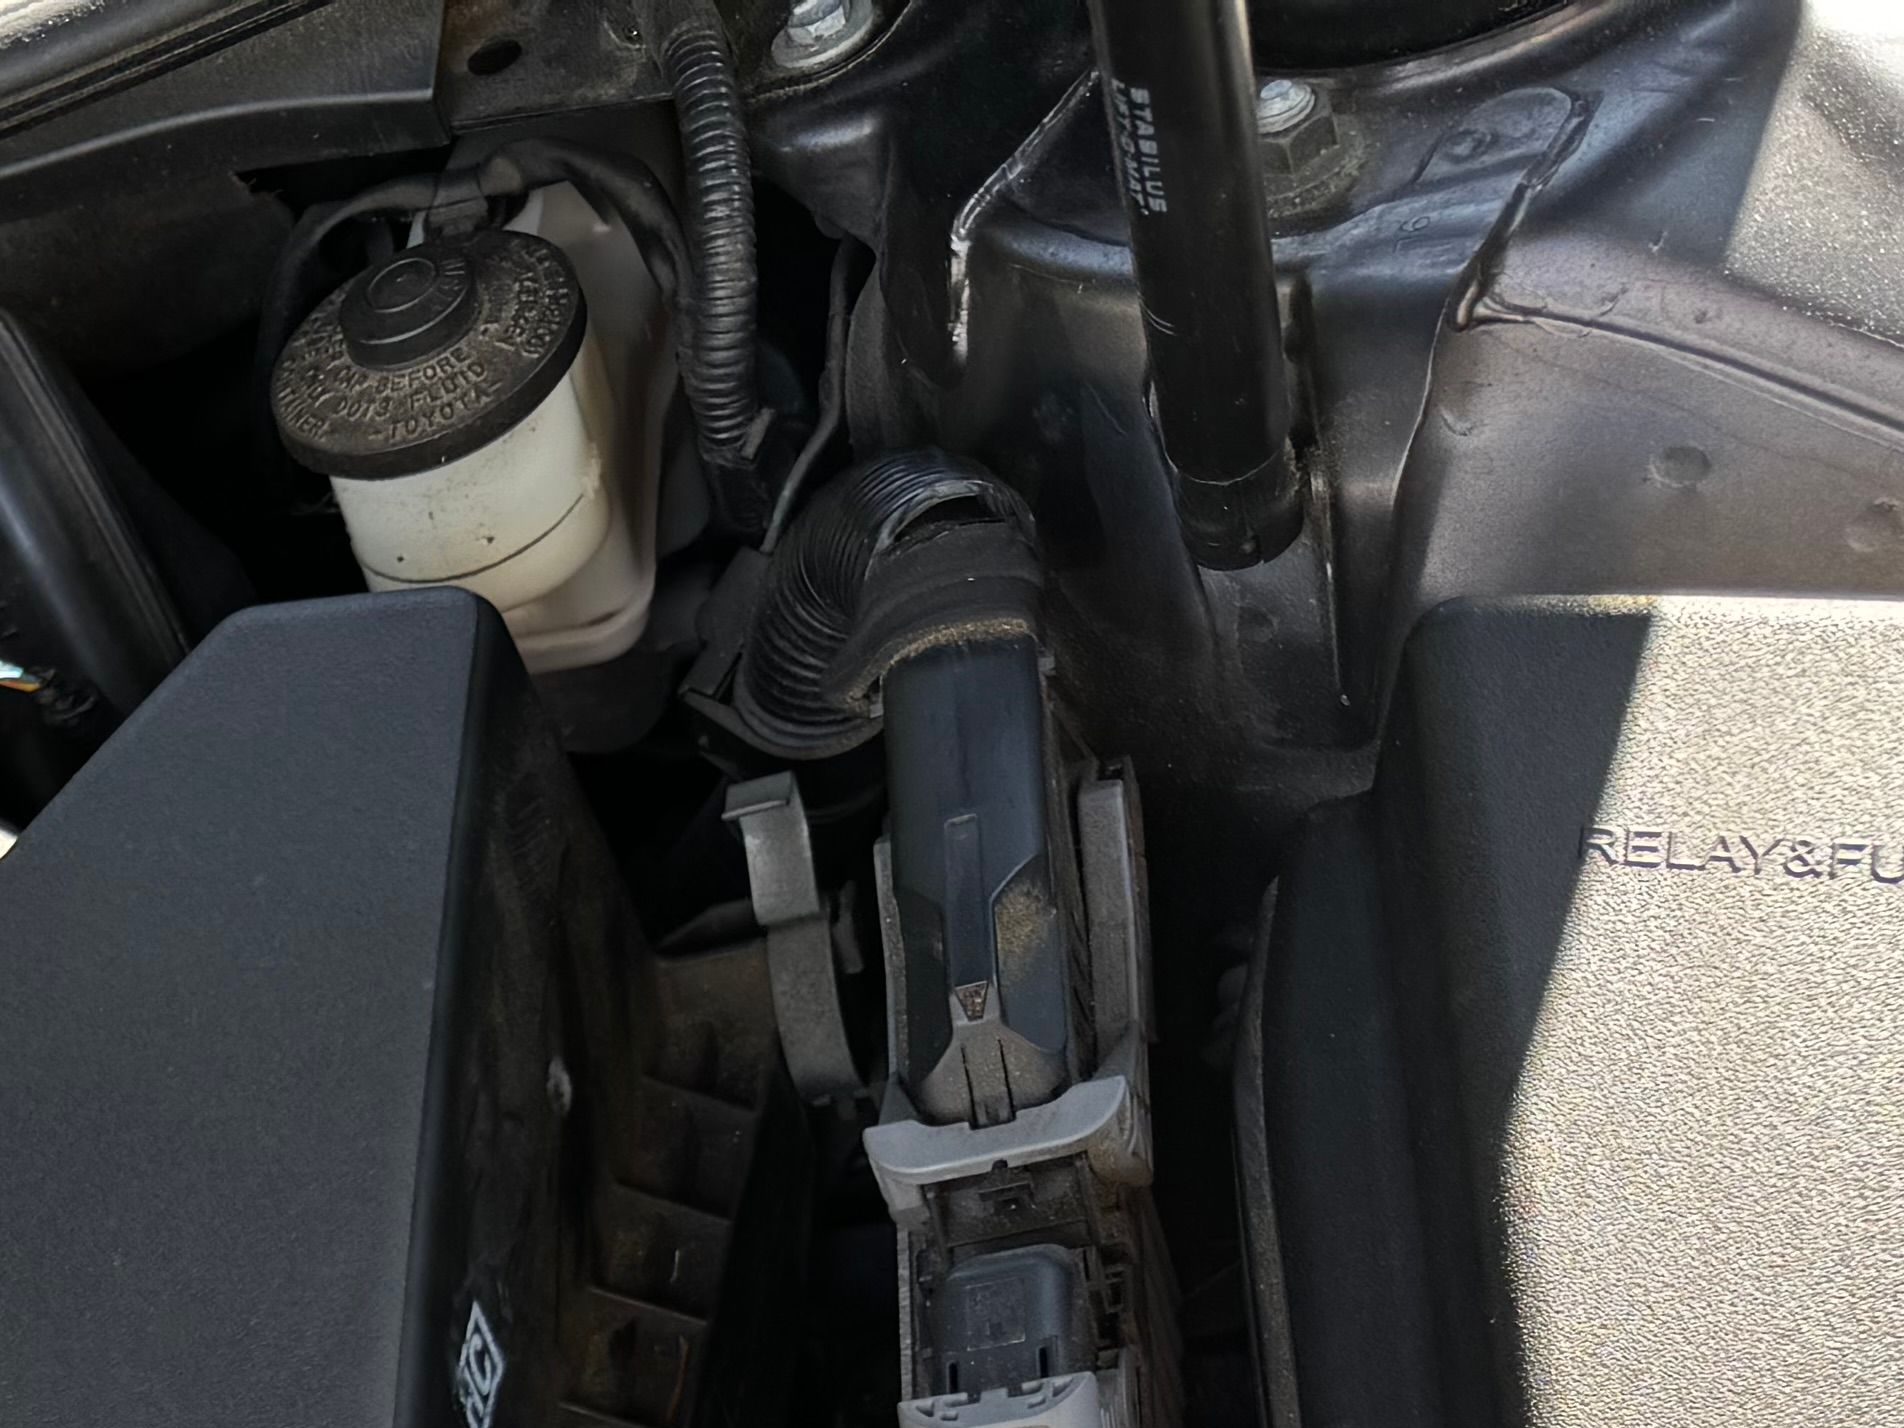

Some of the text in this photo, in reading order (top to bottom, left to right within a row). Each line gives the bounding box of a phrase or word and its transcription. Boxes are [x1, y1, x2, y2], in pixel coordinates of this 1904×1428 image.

[1130, 87, 1167, 212] STABILUS
[375, 347, 468, 396] BEFORE
[408, 361, 487, 411] FLUID
